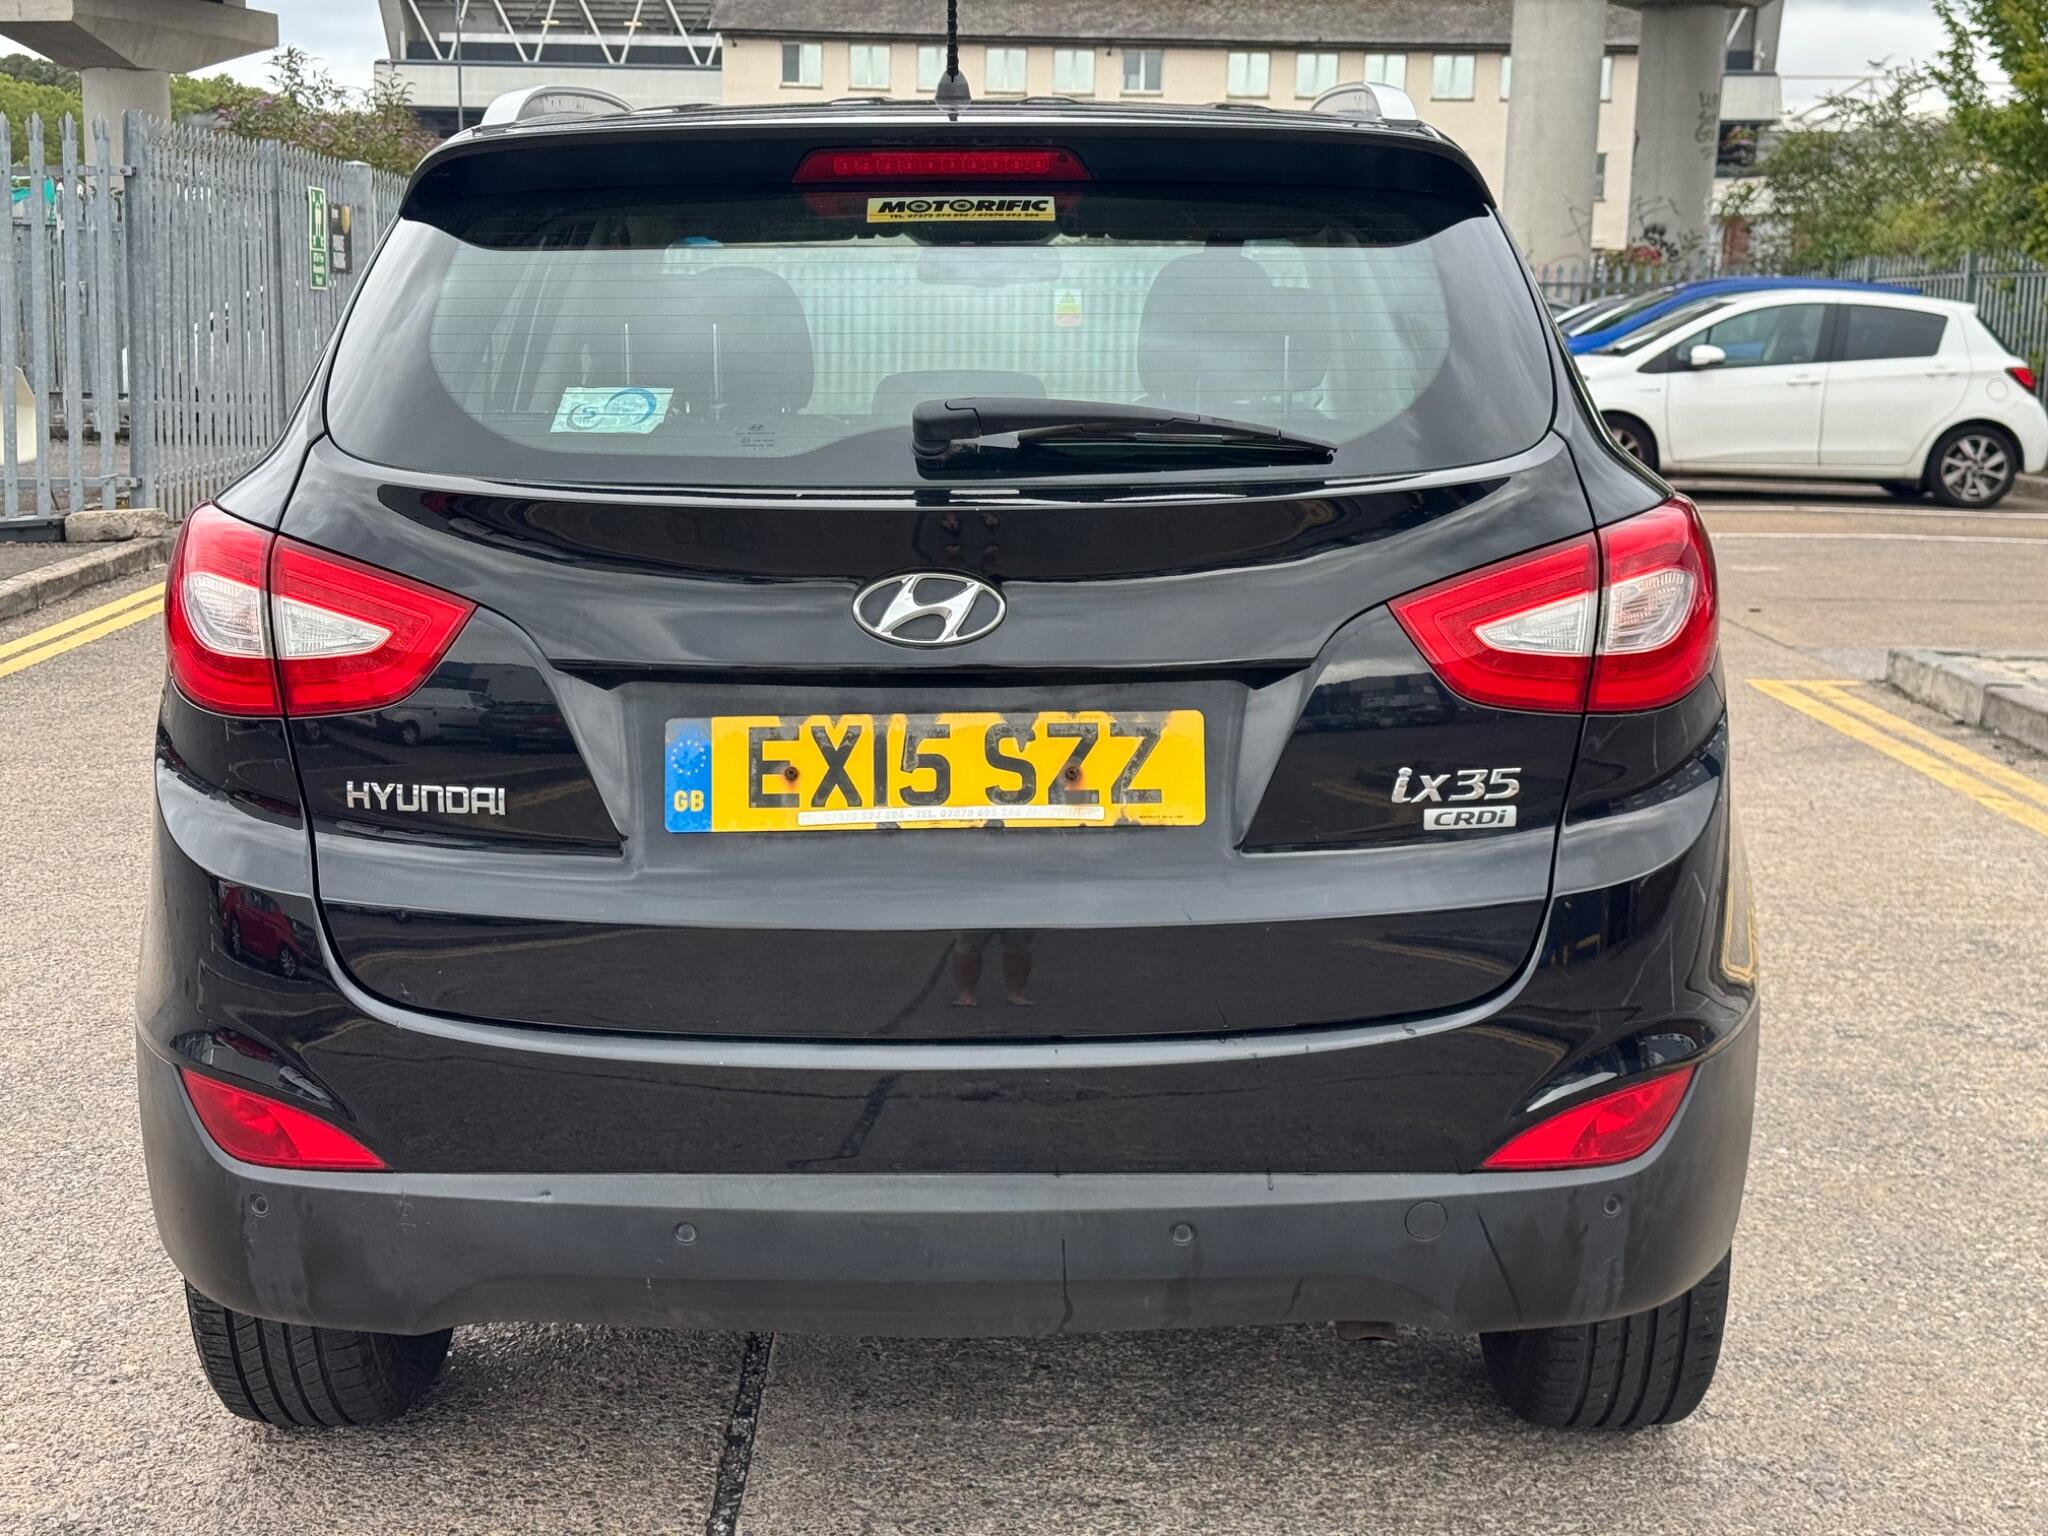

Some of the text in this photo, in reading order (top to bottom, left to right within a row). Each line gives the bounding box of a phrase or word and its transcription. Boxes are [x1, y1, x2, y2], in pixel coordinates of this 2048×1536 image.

[877, 200, 1049, 213] MOTORIFIC
[748, 722, 1163, 808] EX15 SZZ
[346, 780, 506, 816] HYUNDAI
[1391, 767, 1522, 803] ix35
[673, 790, 705, 812] GB
[1433, 809, 1507, 827] CRDi
